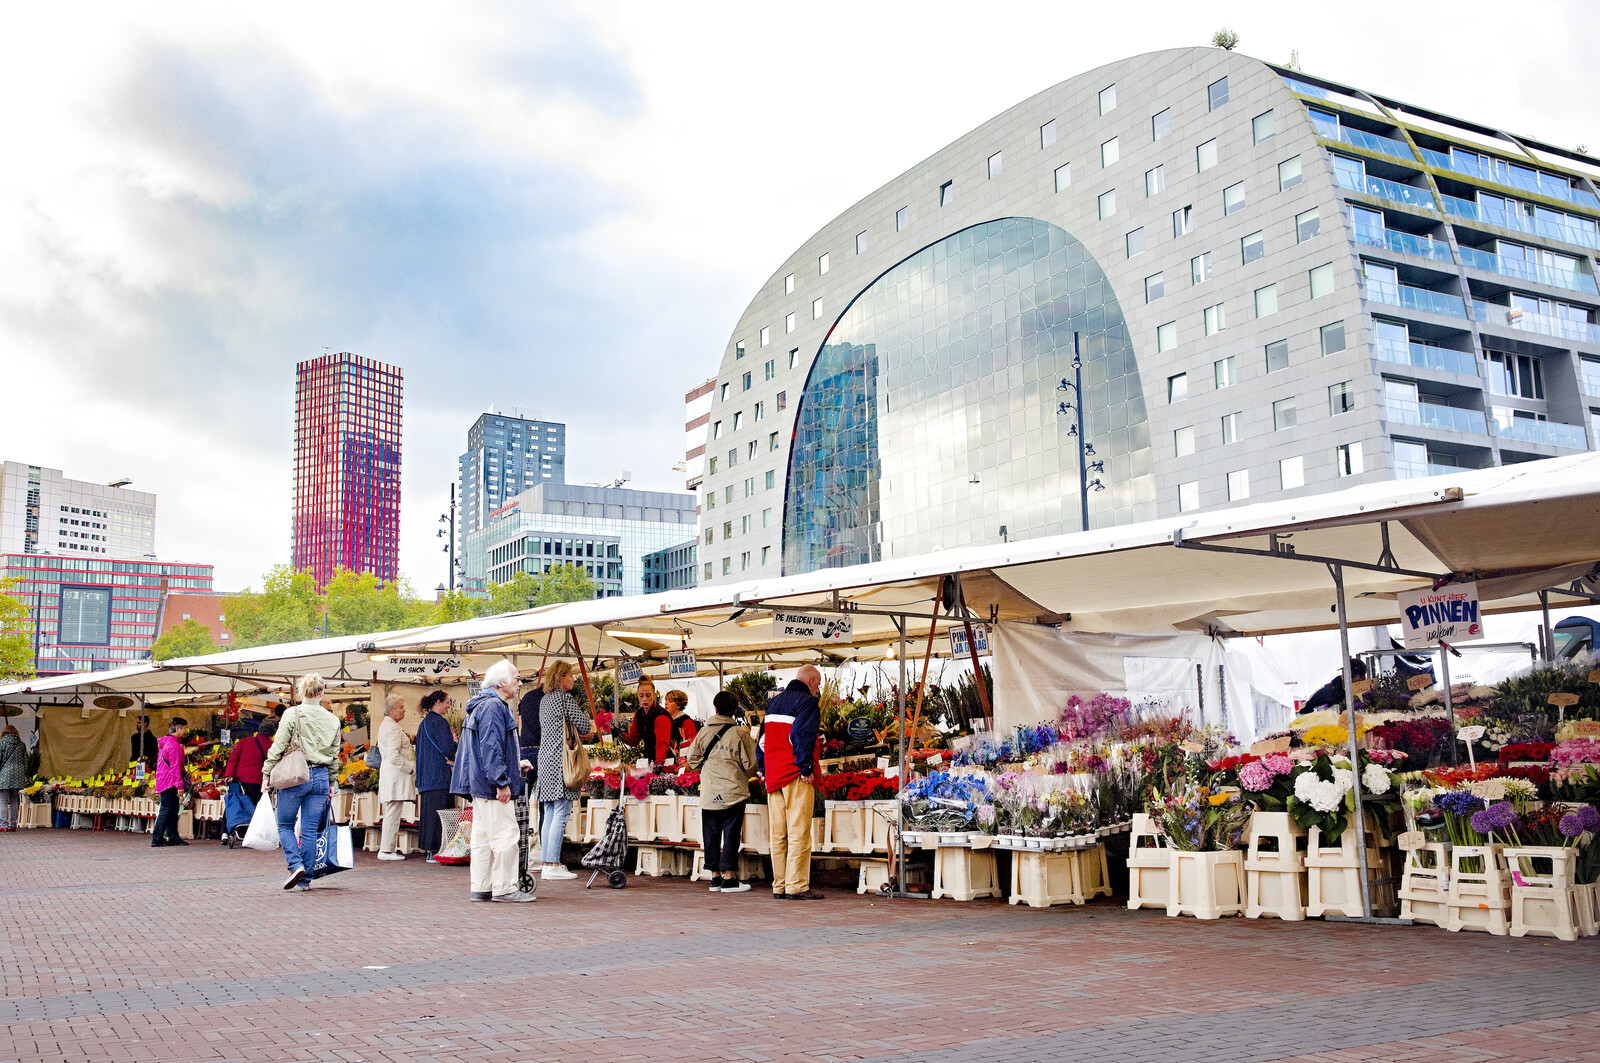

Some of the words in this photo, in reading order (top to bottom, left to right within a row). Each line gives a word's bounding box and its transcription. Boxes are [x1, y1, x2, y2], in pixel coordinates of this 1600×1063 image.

[1427, 594, 1447, 603] KUNT
[1448, 593, 1468, 601] HIER
[775, 613, 785, 621] DE
[785, 614, 812, 625] MEIDEN
[813, 617, 827, 626] VAN
[1405, 600, 1477, 630] PINNEN
[784, 626, 794, 635] DE
[794, 627, 815, 637] SNOR
[952, 629, 977, 643] PINNN
[954, 642, 964, 654] JA
[964, 639, 987, 652] GAAG
[390, 657, 399, 665] DE
[670, 655, 688, 664] PINNEN
[407, 666, 426, 674] SNOR
[671, 664, 679, 674] JA
[679, 664, 695, 673] GRAAG
